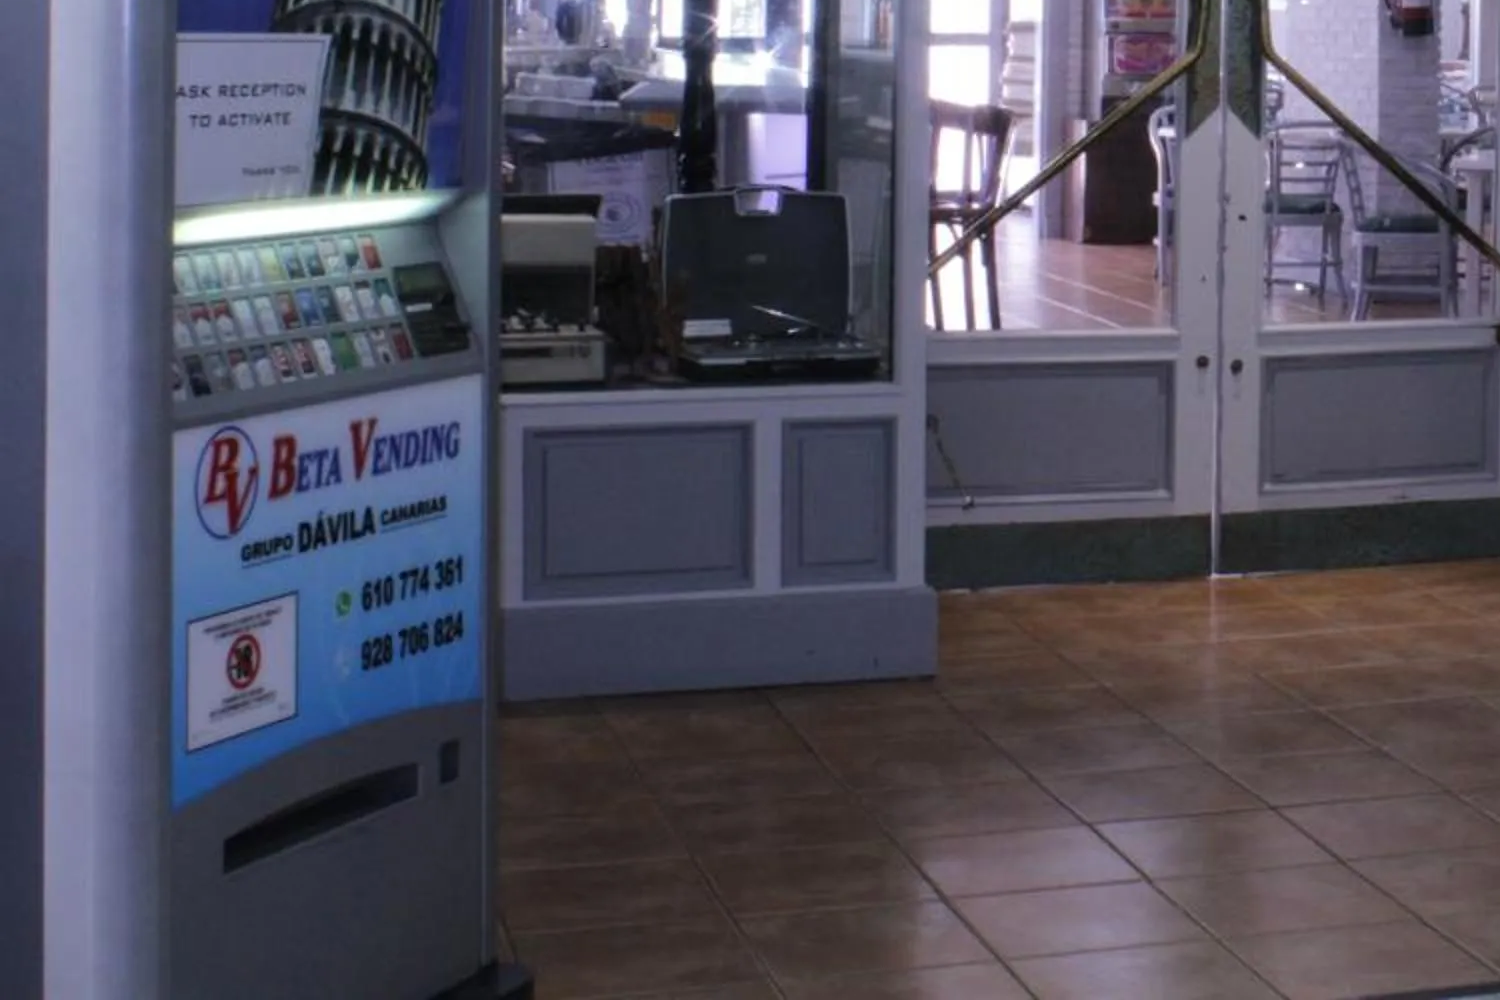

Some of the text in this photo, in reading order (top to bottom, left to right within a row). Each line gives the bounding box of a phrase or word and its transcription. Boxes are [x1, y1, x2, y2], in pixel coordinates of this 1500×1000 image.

[176, 83, 307, 99] ASK RECEPTION
[189, 111, 292, 128] TO ACTIVATE
[240, 495, 448, 563] GRUPO DÁVILA CANARIAS
[361, 574, 394, 612] 610
[398, 564, 430, 600] 774
[361, 609, 464, 672] 928 706 824
